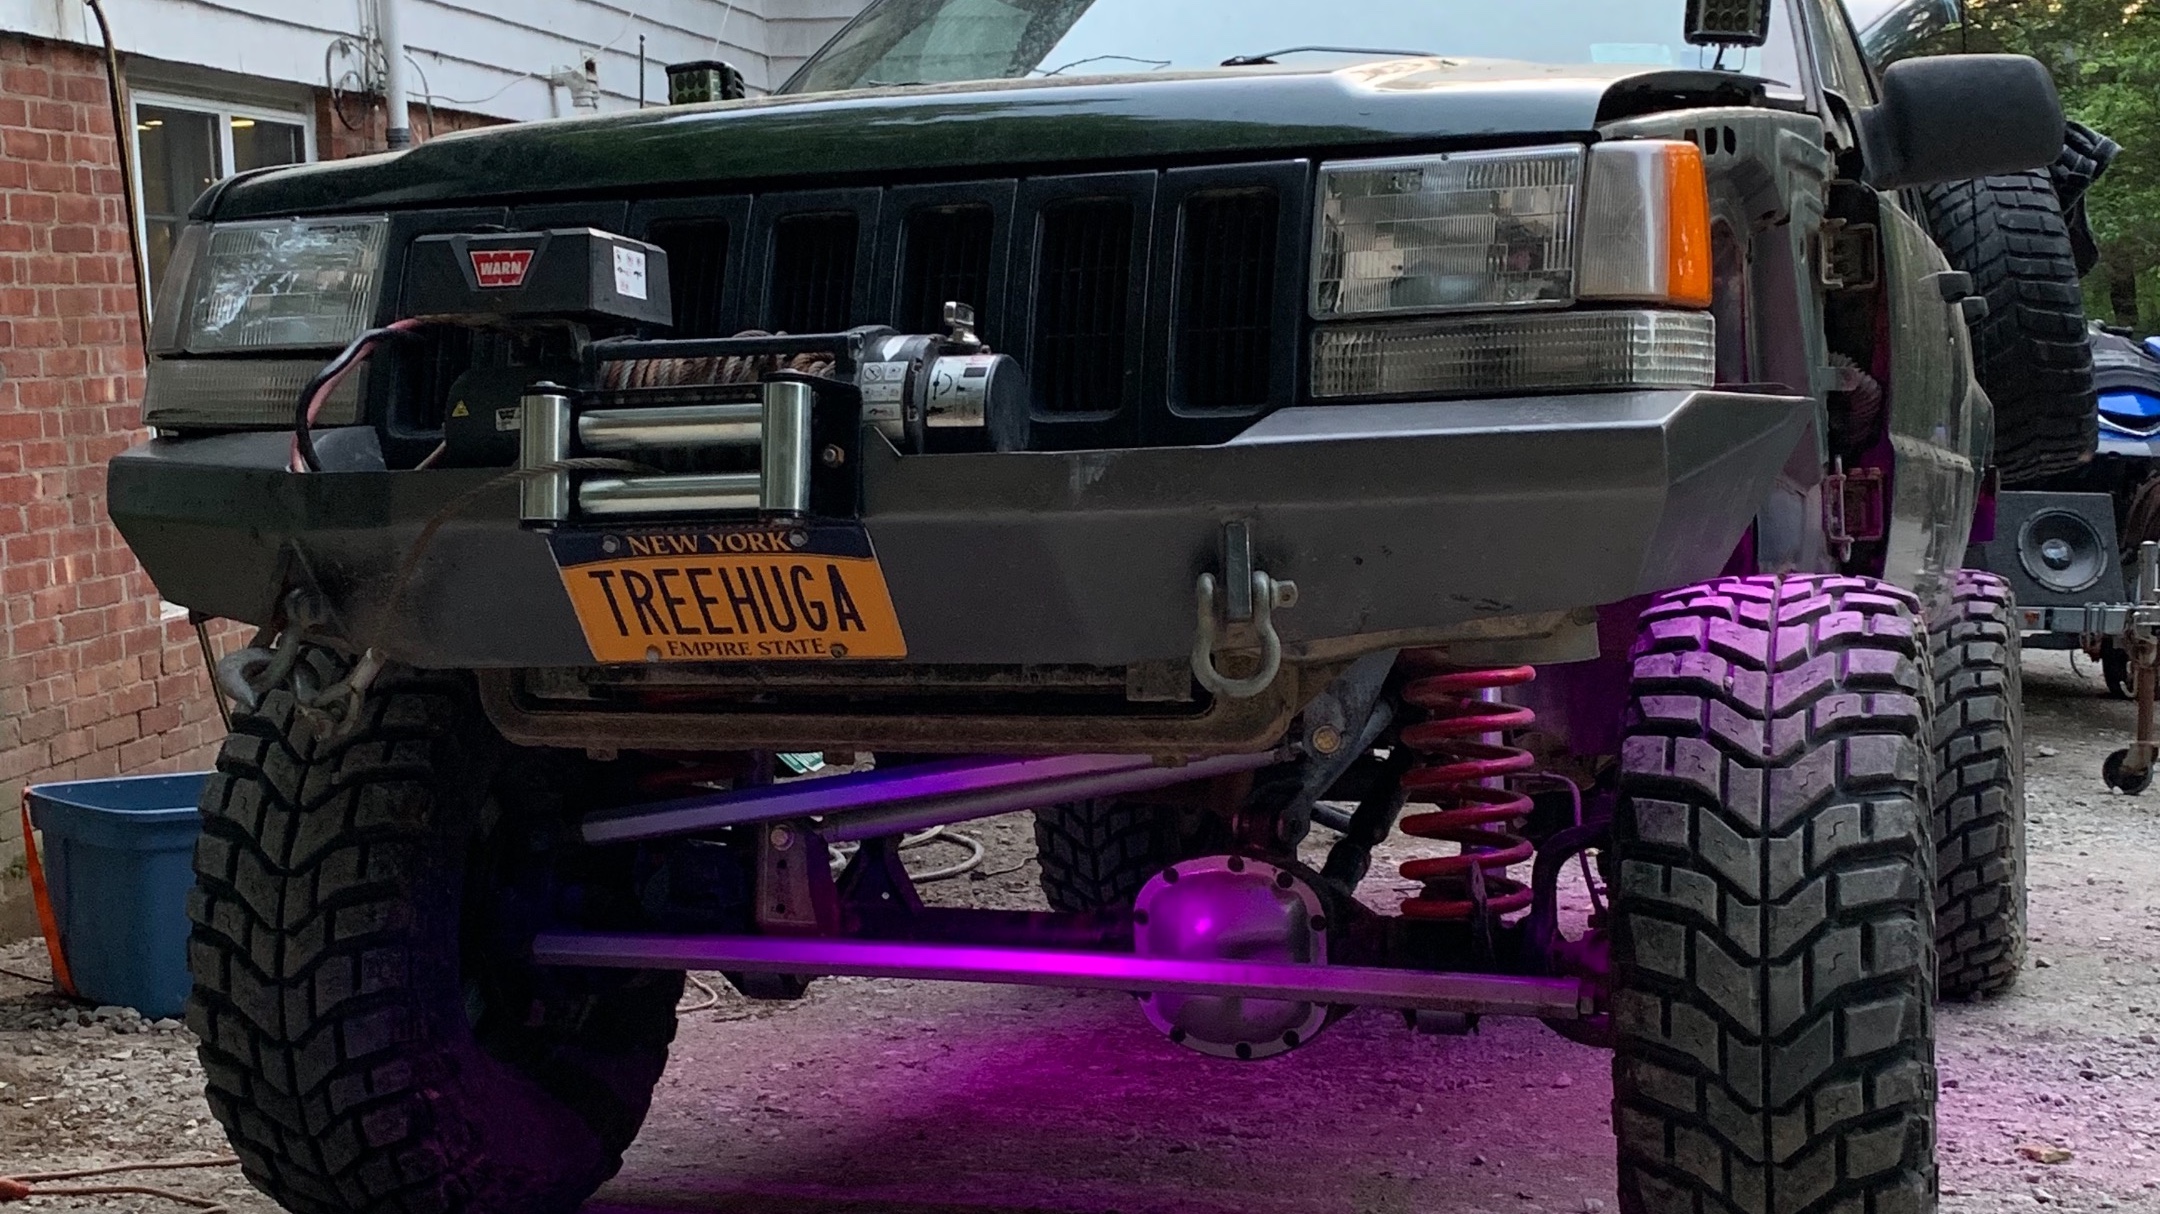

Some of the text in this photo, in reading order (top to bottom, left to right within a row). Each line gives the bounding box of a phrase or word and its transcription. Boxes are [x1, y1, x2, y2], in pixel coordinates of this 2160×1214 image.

[480, 261, 522, 275] WARN
[627, 531, 792, 557] NEW YORK
[589, 564, 866, 636] TREEHUGA
[667, 637, 826, 657] EMPIRE STATE
